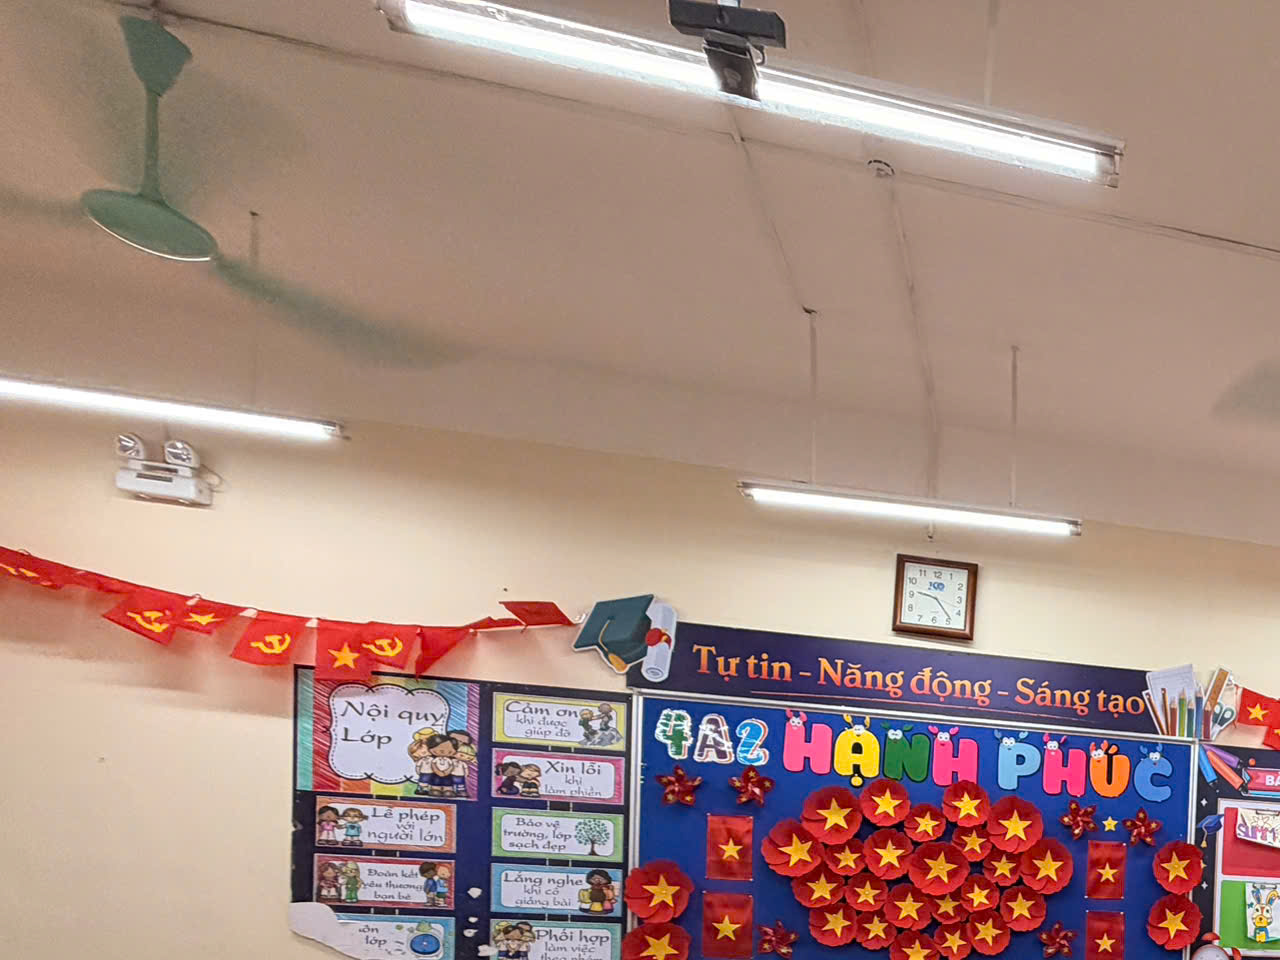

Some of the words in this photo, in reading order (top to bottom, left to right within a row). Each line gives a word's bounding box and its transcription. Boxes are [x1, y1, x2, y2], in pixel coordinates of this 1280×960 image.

[919, 569, 927, 577] 11
[934, 571, 942, 579] 12
[908, 577, 917, 585] 10
[957, 583, 964, 591] 2
[908, 590, 915, 598] 9
[956, 596, 962, 604] 3
[907, 604, 913, 612] 8
[931, 616, 937, 624] 6
[945, 618, 951, 626] 5
[692, 644, 740, 682] Tự
[746, 652, 793, 682] tin
[817, 657, 905, 698] Năng
[909, 666, 992, 707] động
[1014, 677, 1091, 716] Sáng
[1096, 690, 1145, 719] tạo
[340, 700, 389, 722] Nội
[397, 709, 444, 727] quy
[506, 700, 550, 716] Cảm
[556, 708, 578, 718] ơn
[516, 714, 534, 725] khi
[524, 727, 551, 738] giúp
[340, 727, 392, 750] Lớp
[654, 708, 770, 767] 4A2
[782, 708, 978, 788] HẠNH
[997, 731, 1174, 803] PHÚC
[545, 760, 575, 774] Xin
[581, 762, 601, 775] lỗi
[565, 775, 582, 786] khi
[398, 808, 440, 824] phép
[396, 821, 415, 831] với
[515, 817, 543, 828] Bảo
[545, 820, 560, 830] vệ
[367, 830, 414, 844] người
[420, 828, 444, 842] lớn
[552, 829, 572, 842] lớp
[508, 840, 540, 851] sạch
[367, 868, 399, 878] Đoàn
[401, 869, 418, 879] kết
[503, 872, 543, 885] Lắng
[547, 874, 584, 888] nghe
[523, 884, 542, 896] khi
[374, 890, 395, 902] bạn
[553, 897, 572, 907] bài
[535, 929, 574, 943] Phối
[579, 930, 610, 947] hợp
[544, 942, 567, 952] làm
[571, 945, 596, 956] việc
